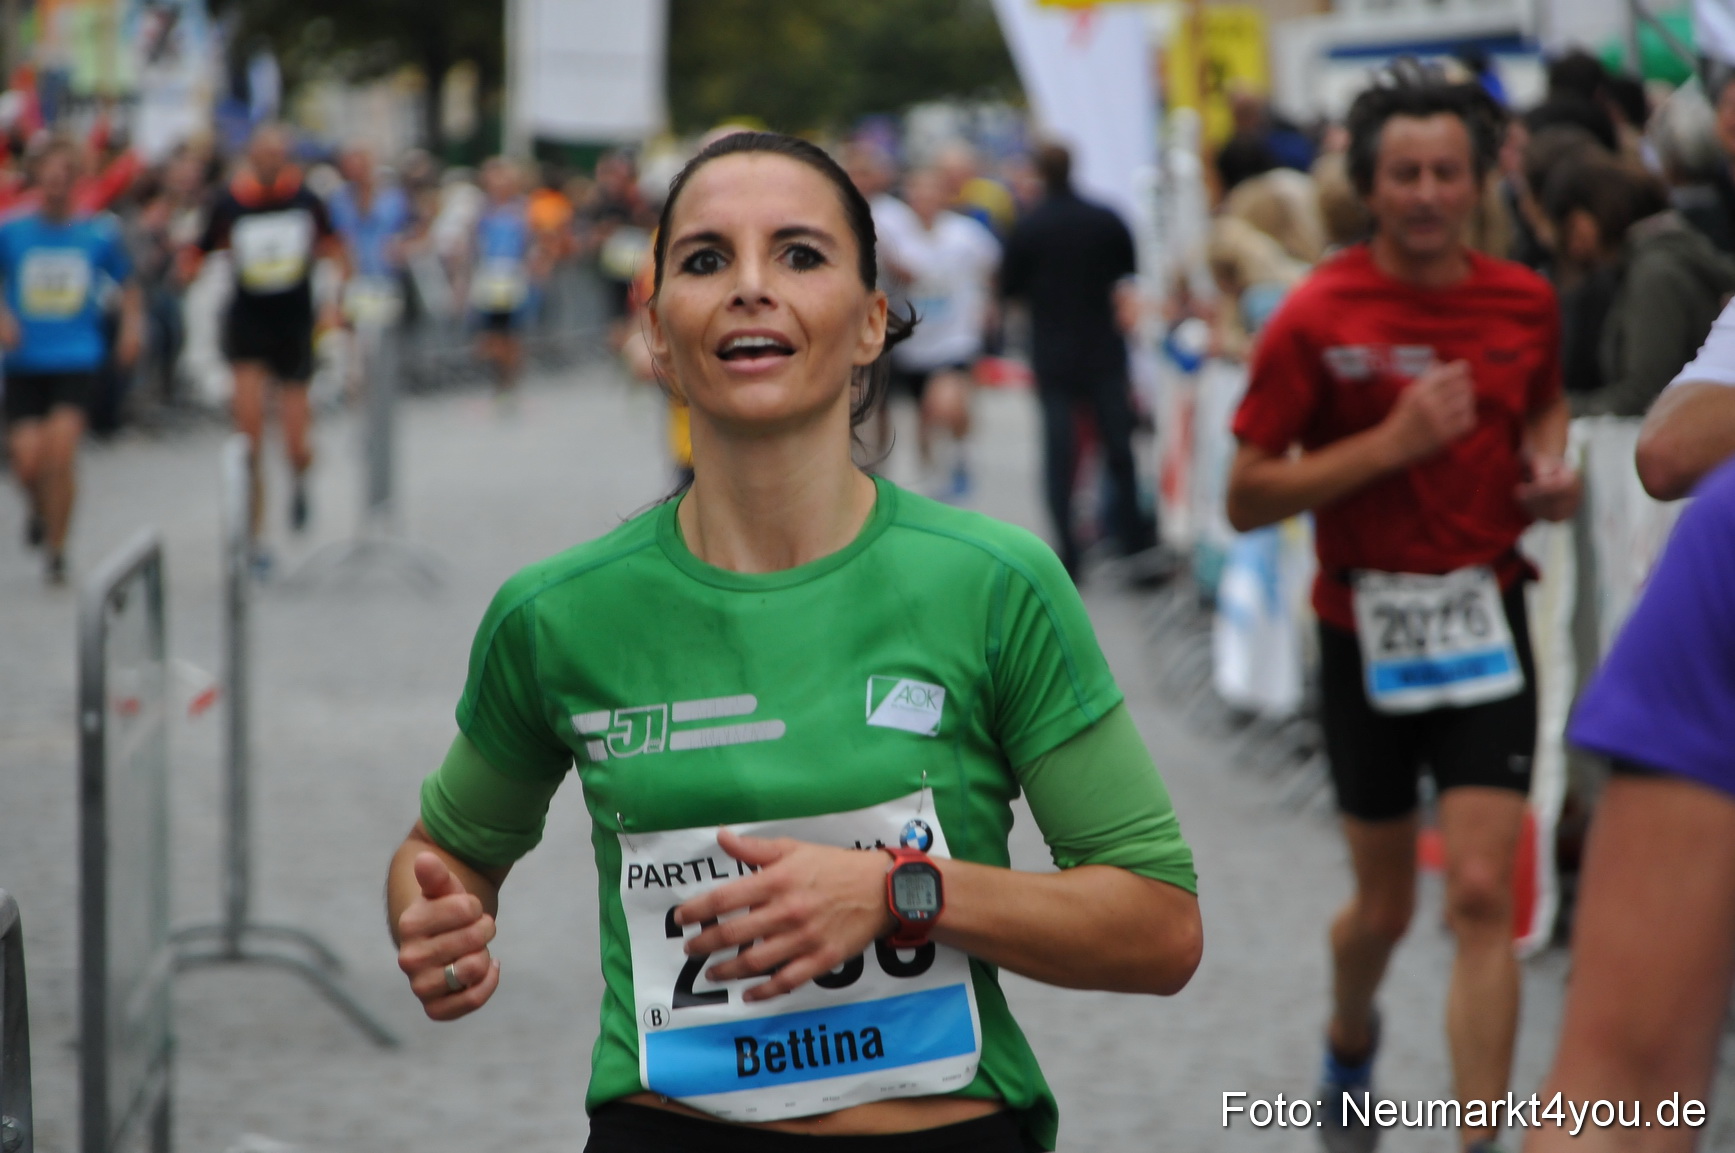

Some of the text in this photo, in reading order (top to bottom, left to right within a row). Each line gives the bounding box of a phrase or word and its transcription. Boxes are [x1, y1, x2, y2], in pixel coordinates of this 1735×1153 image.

[894, 685, 940, 711] AOK
[627, 857, 728, 889] PARTL
[651, 1008, 662, 1027] B
[735, 1023, 884, 1078] Bettina
